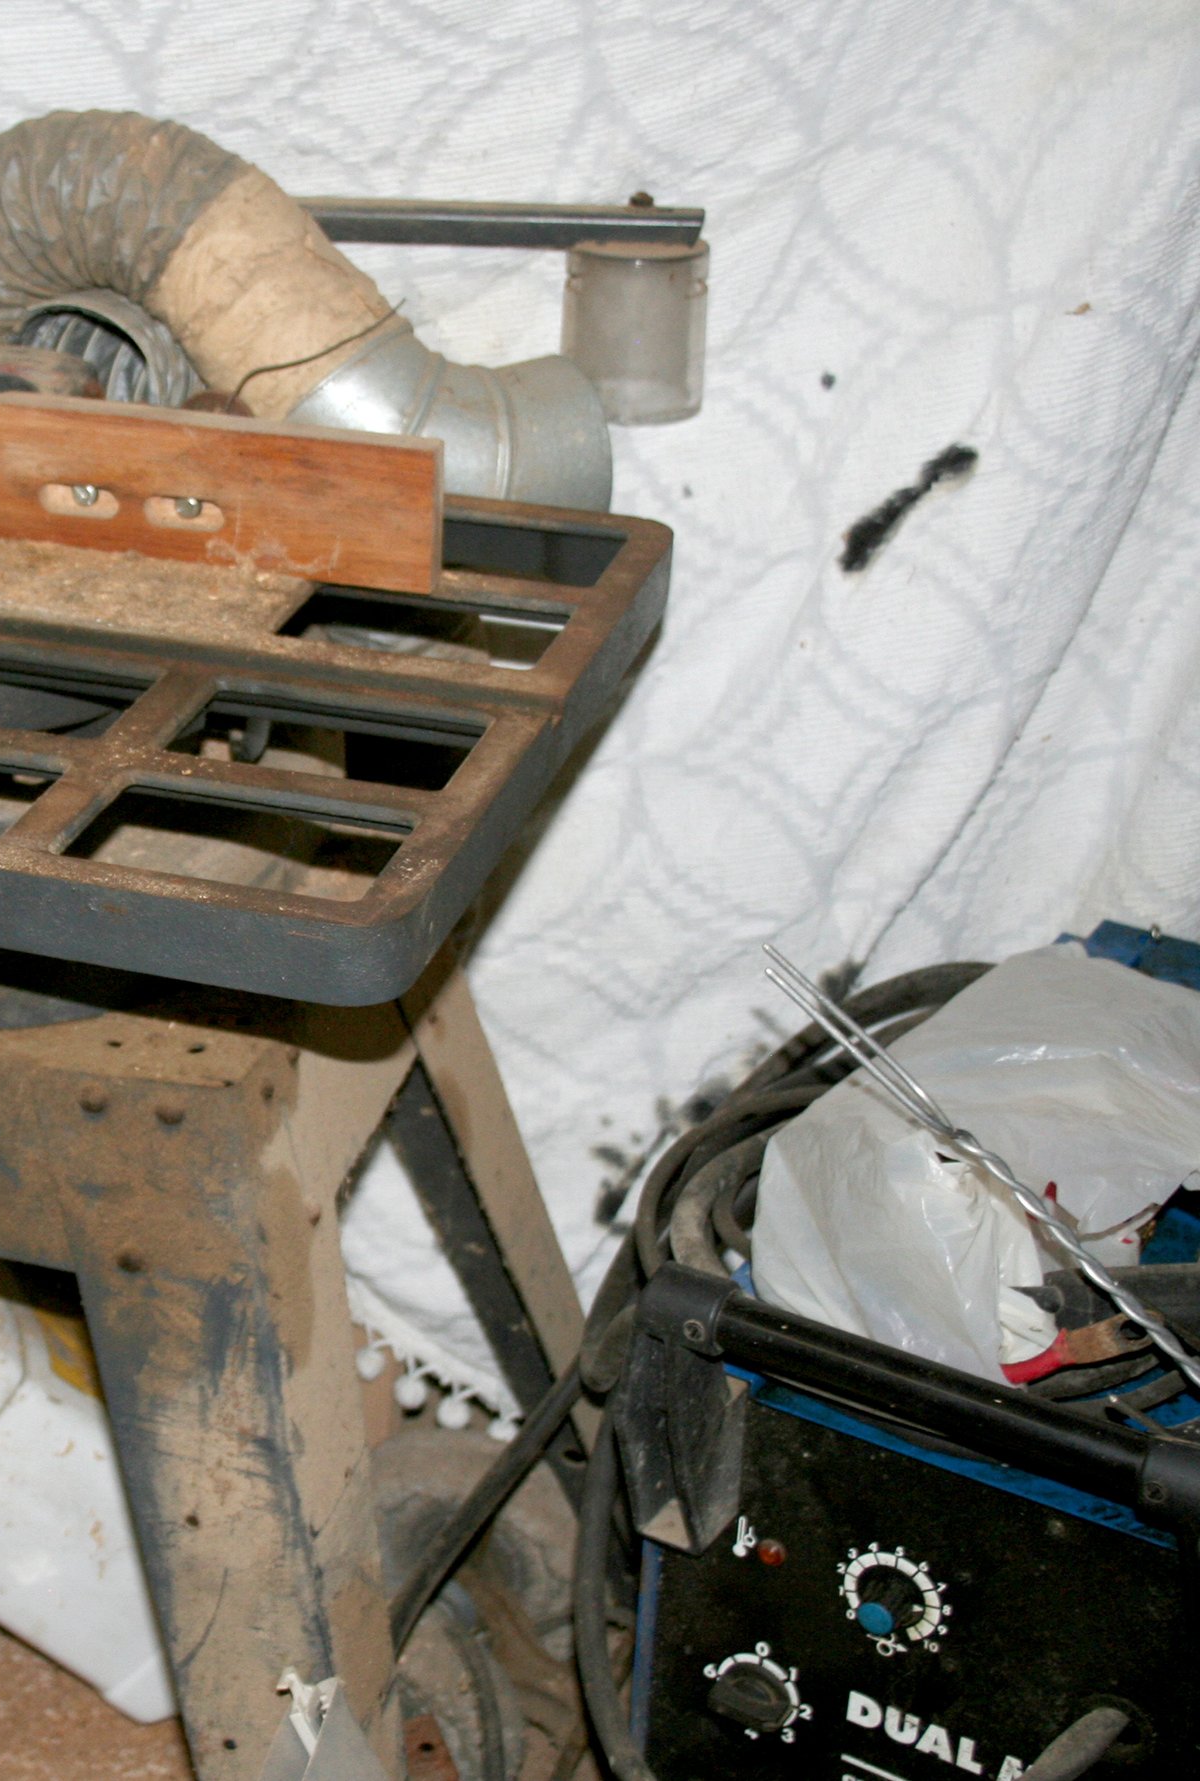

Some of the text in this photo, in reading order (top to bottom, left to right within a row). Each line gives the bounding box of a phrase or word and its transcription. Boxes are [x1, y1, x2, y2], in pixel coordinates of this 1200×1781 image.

[847, 1547, 858, 1559] 3
[836, 1562, 846, 1574] 2
[942, 1604, 952, 1616] 8
[755, 1641, 770, 1657] 0
[788, 1666, 799, 1682] 1
[798, 1703, 814, 1721] 2
[781, 1727, 796, 1744] 3
[845, 1689, 985, 1776] DUAL
